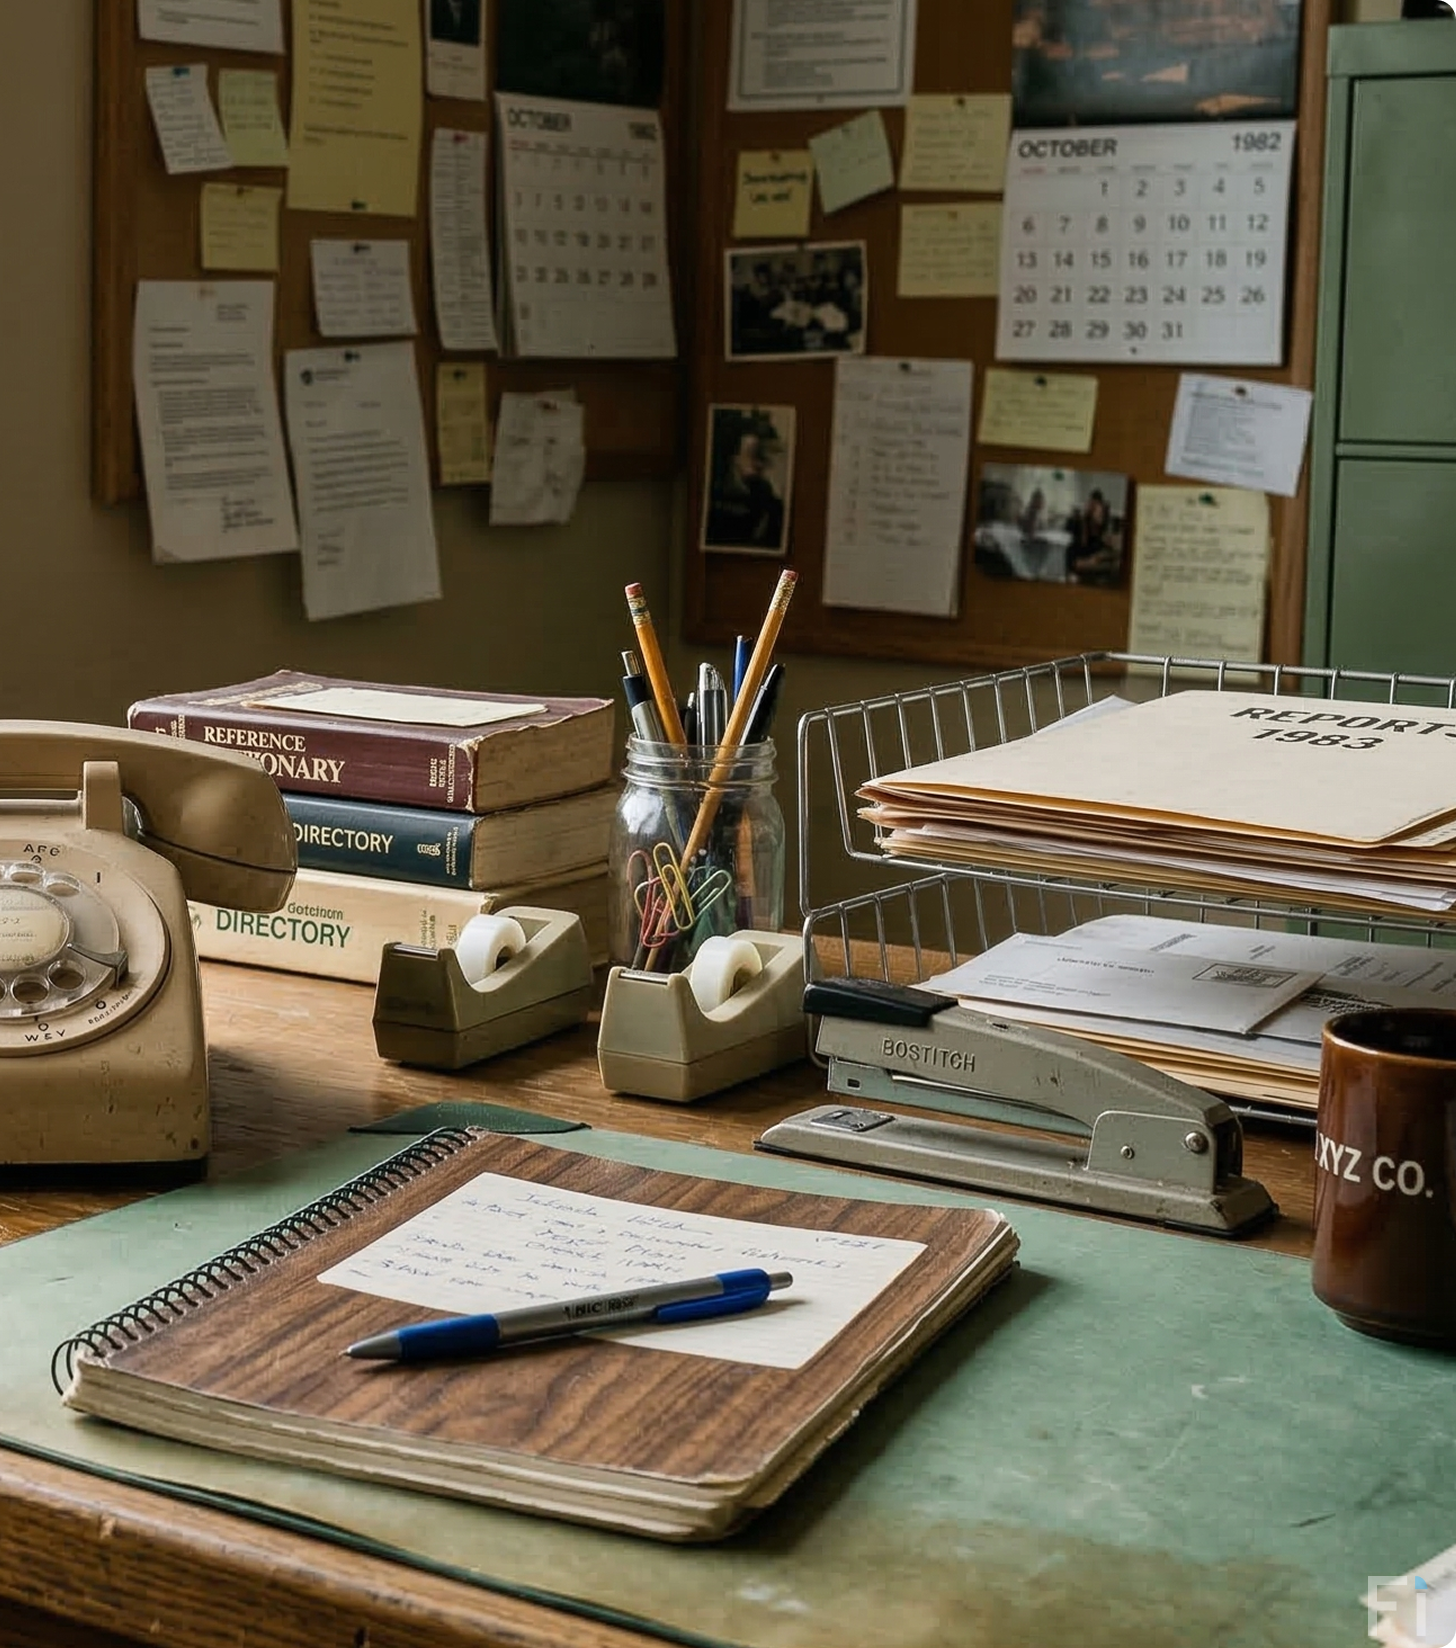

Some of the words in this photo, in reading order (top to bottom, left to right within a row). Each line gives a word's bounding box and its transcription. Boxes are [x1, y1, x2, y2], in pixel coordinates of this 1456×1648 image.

[1018, 138, 1117, 158] OCTOBER
[1232, 131, 1282, 151] 1982
[1100, 179, 1109, 196] 1
[1137, 179, 1148, 196] 2
[1174, 178, 1186, 195] 3
[1213, 177, 1225, 194] 4
[1254, 177, 1265, 194] 5
[1022, 216, 1034, 233] 6
[1060, 216, 1071, 233] 7
[1096, 216, 1108, 233] 8
[1133, 215, 1146, 232] 9
[1169, 214, 1191, 231] 10
[1209, 214, 1227, 231] 11
[1248, 214, 1269, 231] 12
[1054, 252, 1074, 268] 14
[1092, 252, 1111, 268] 15
[1129, 252, 1149, 268] 16
[1167, 251, 1187, 267] 17
[1206, 251, 1227, 267] 18
[1246, 251, 1266, 267] 19
[1014, 286, 1037, 303] 20
[1050, 286, 1072, 303] 21
[1087, 286, 1111, 303] 22
[1125, 286, 1148, 303] 23
[1162, 286, 1186, 303] 24
[1201, 286, 1225, 303] 25
[1242, 286, 1265, 303] 26
[1013, 320, 1036, 338] 27
[1049, 320, 1072, 338] 28
[1086, 321, 1110, 339] 29
[1124, 321, 1148, 339] 30
[1162, 321, 1183, 339] 31
[1230, 707, 1456, 738] REPORT
[204, 725, 307, 752] REFERENCE
[1252, 728, 1385, 749] 1983
[236, 751, 346, 784] ONARY
[216, 908, 351, 949] DIRECTORY
[882, 1037, 976, 1072] BOSTITCH
[1372, 1156, 1434, 1198] CO.
